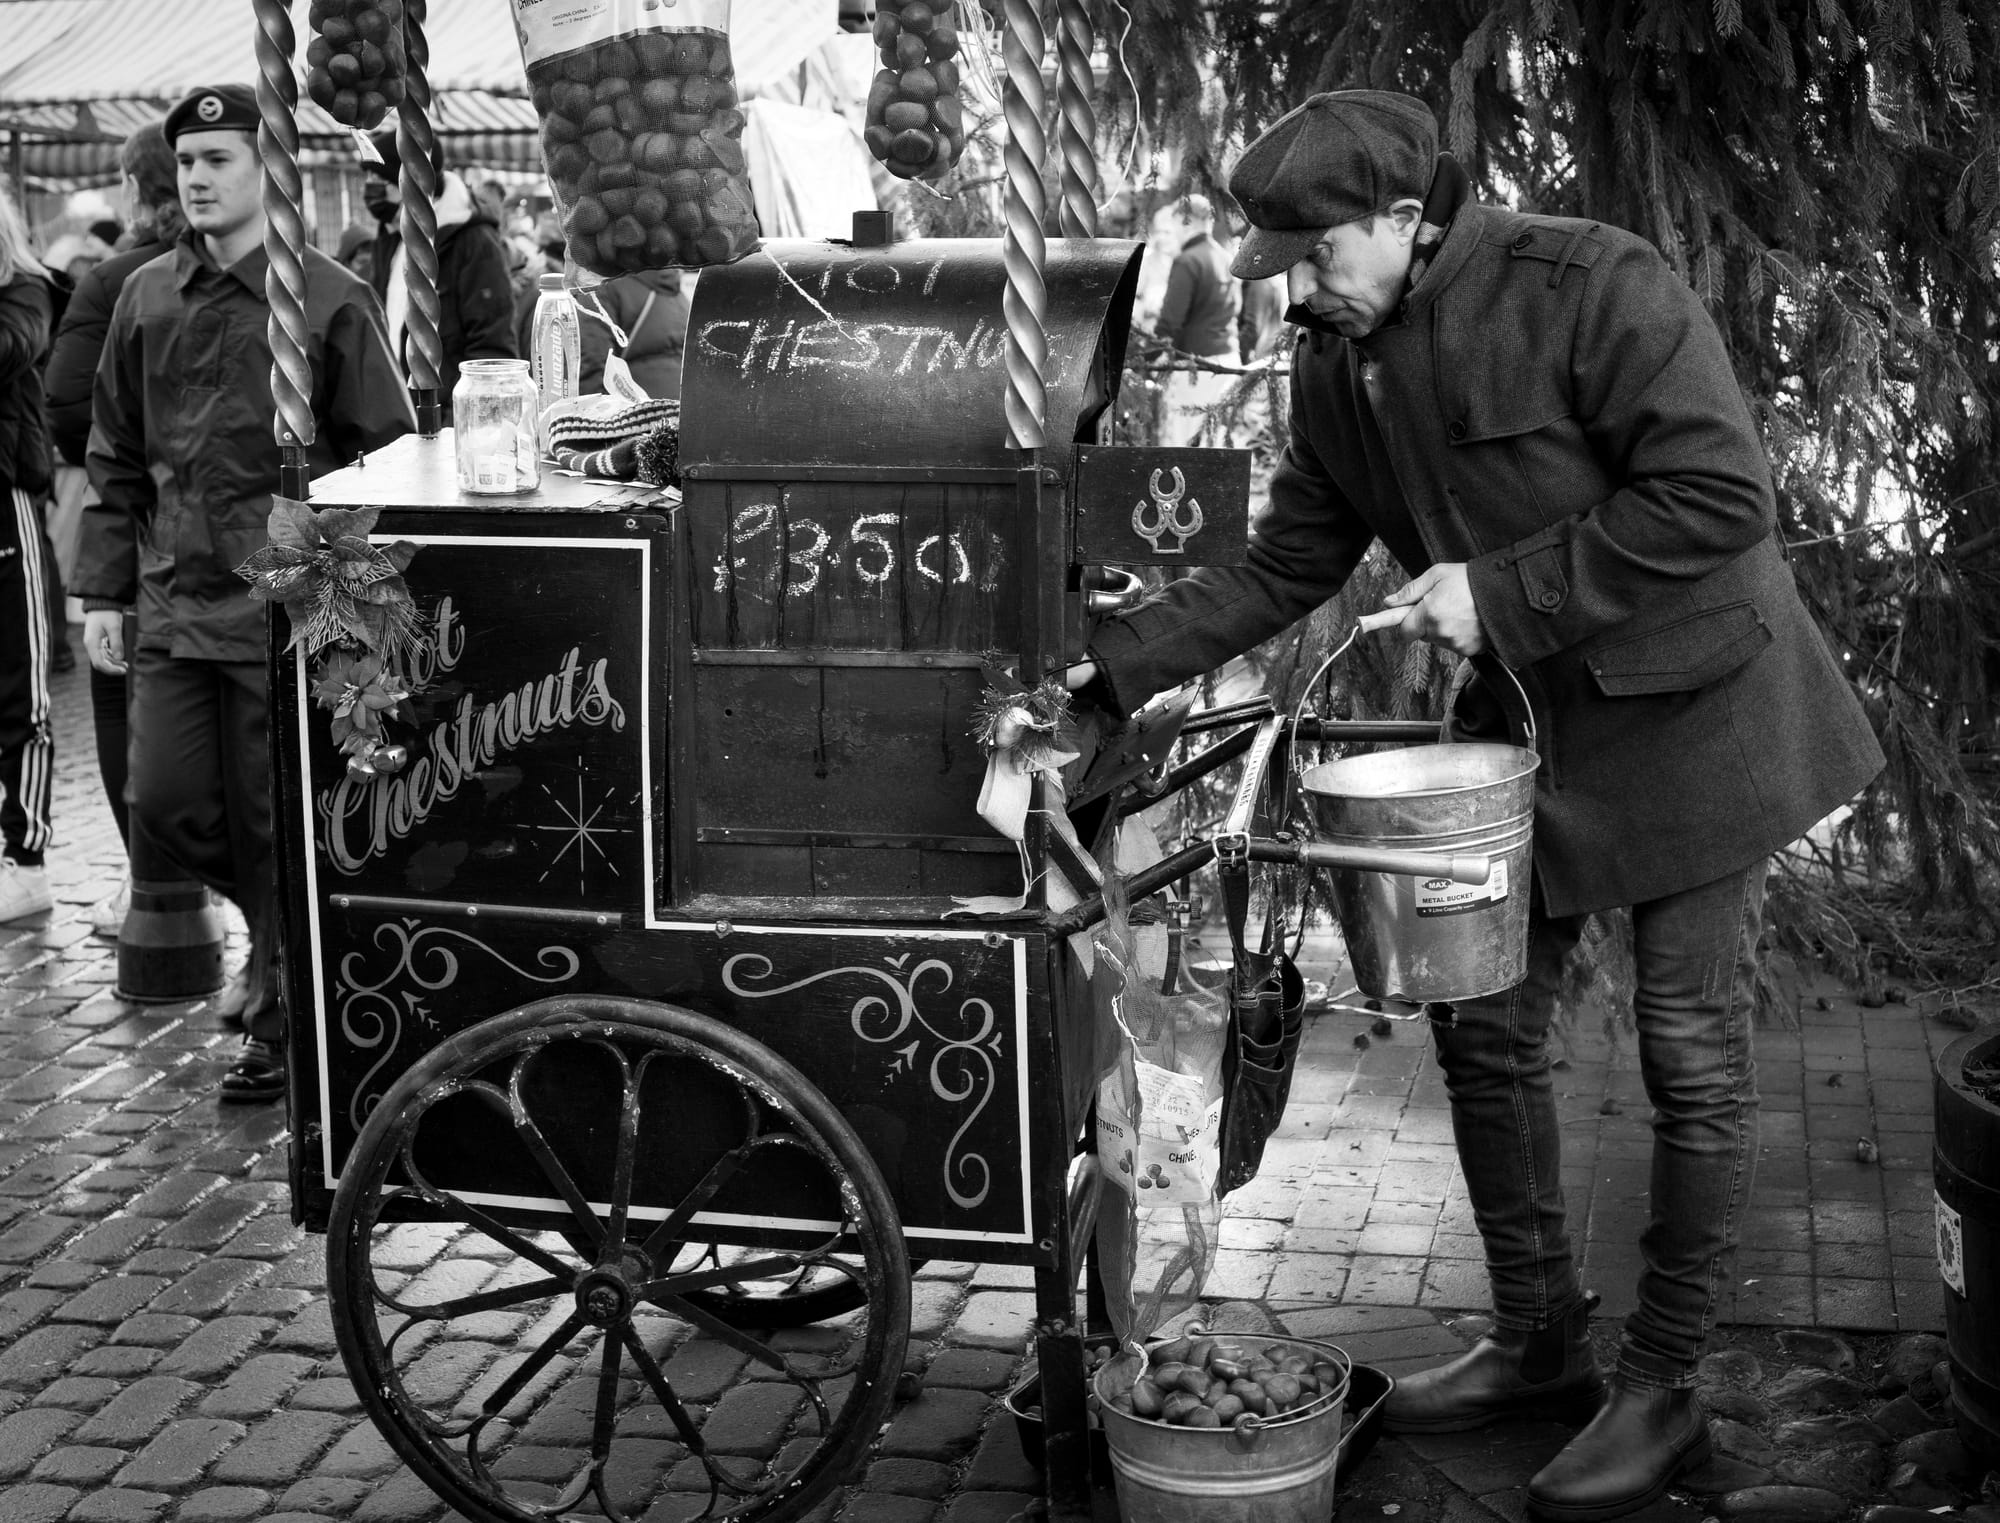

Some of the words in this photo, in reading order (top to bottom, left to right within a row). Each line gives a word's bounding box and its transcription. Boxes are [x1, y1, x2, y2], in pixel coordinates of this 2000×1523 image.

[551, 324, 562, 397] Lucozade
[317, 647, 626, 876] Chestnuts
[1428, 881, 1448, 890] MAX
[1447, 892, 1474, 902] BUCKET
